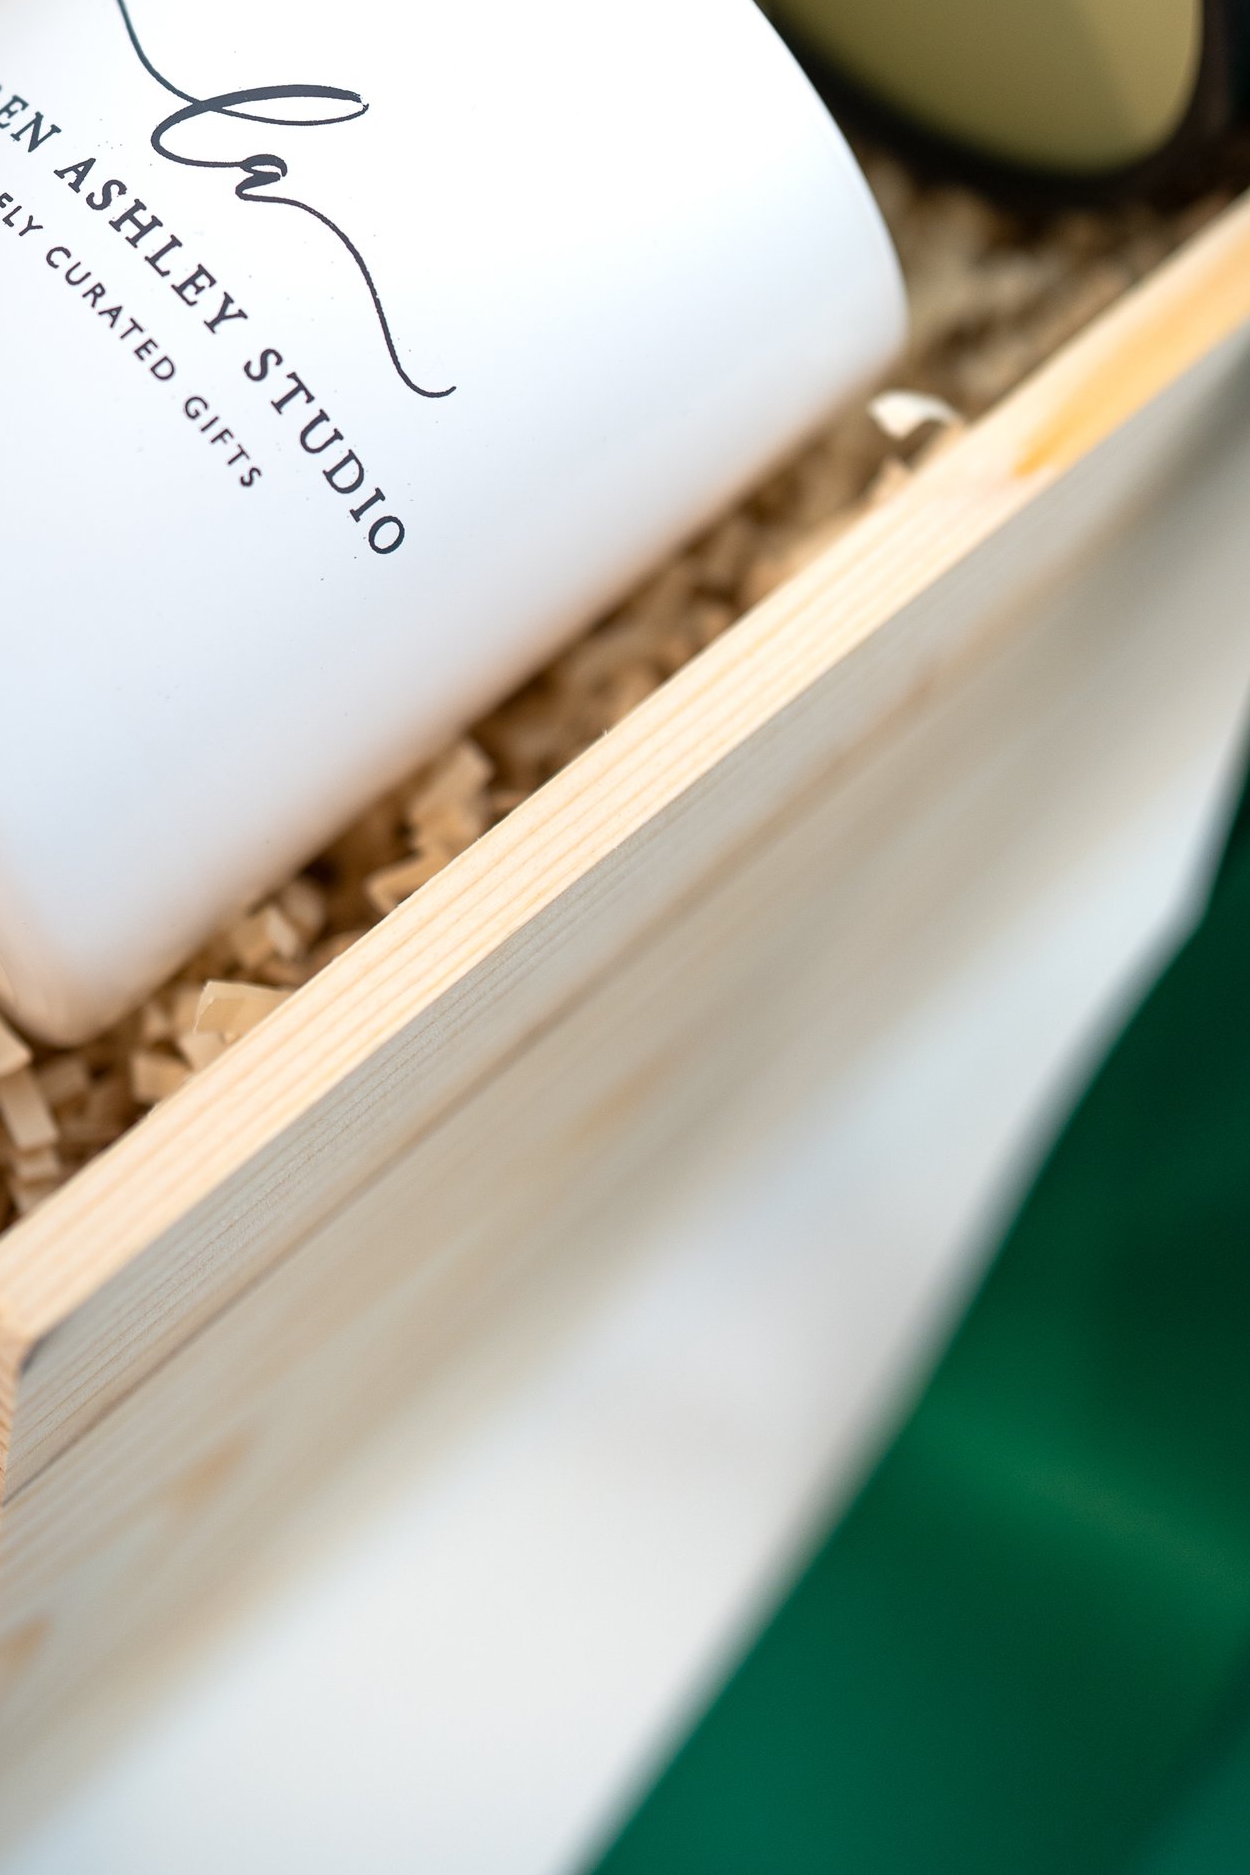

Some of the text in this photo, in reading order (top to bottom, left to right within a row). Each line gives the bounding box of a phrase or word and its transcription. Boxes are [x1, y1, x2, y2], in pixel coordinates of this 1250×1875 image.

[45, 245, 177, 383] CURATED
[182, 394, 263, 489] GIFTS
[53, 157, 250, 336] ASHLEY
[241, 347, 406, 555] STUDIO
